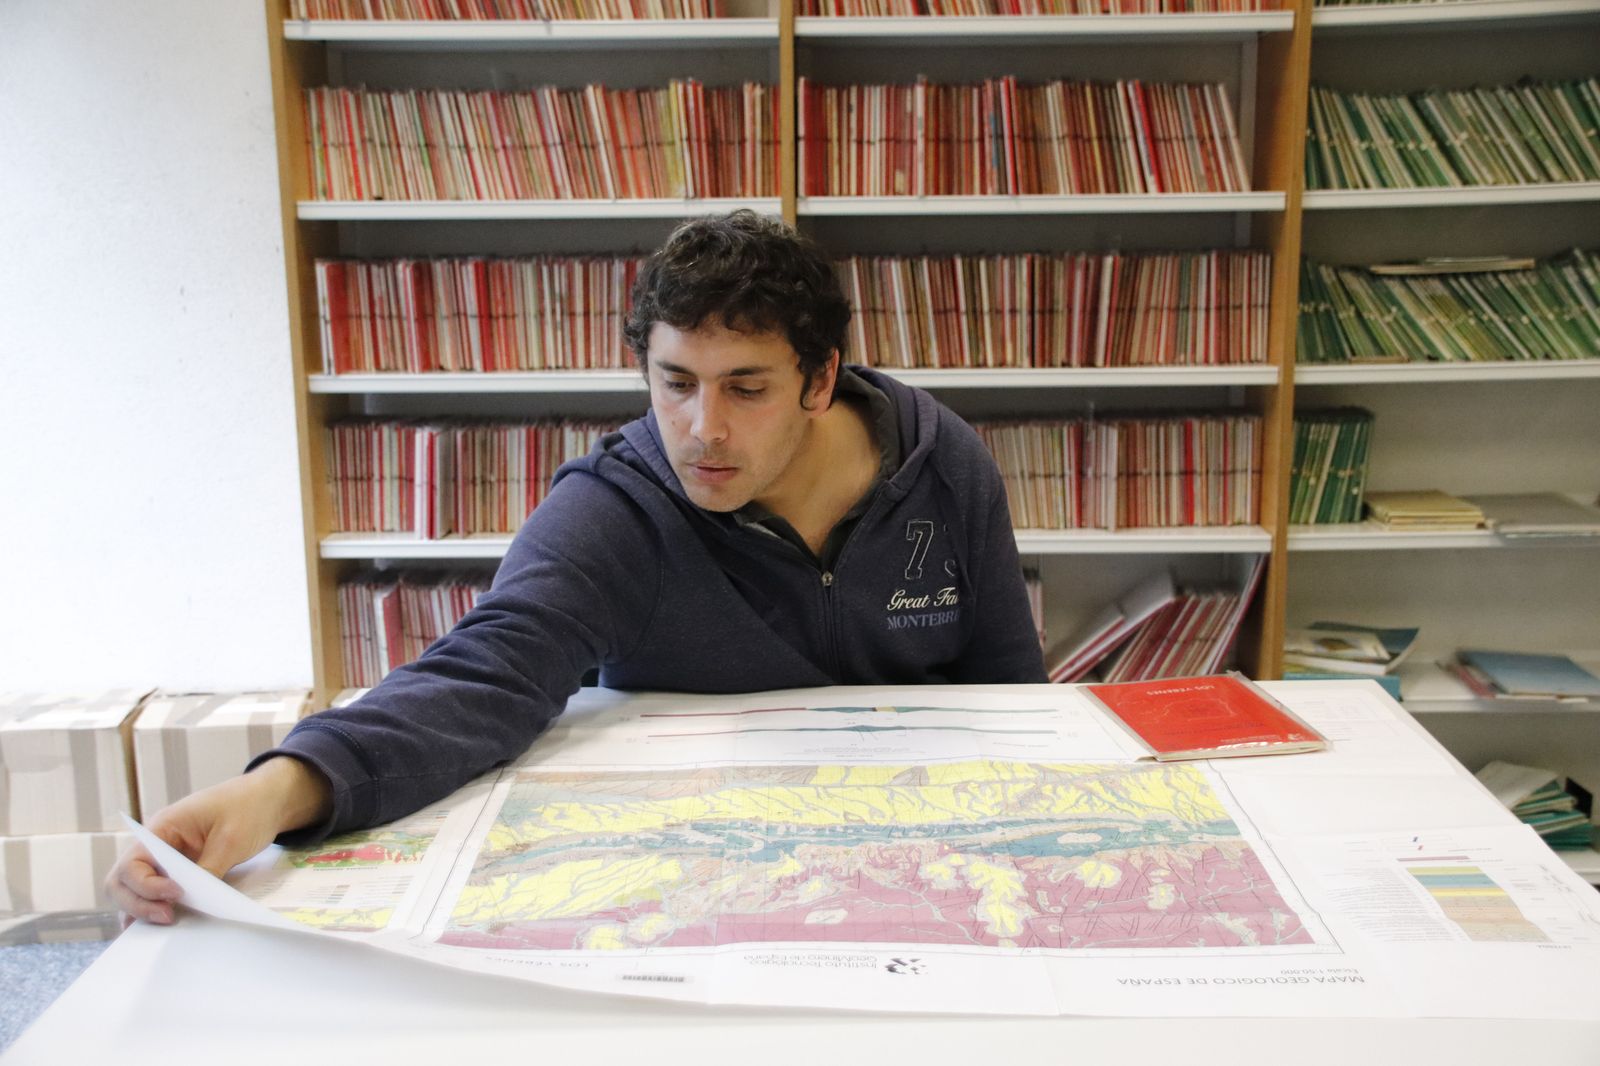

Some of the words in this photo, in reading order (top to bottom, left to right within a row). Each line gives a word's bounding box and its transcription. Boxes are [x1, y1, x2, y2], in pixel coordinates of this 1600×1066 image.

[887, 588, 931, 611] Great
[1115, 977, 1182, 987] ESPAÑA
[1186, 977, 1209, 986] DE
[1211, 976, 1311, 986] GEOLOGICO
[1312, 975, 1366, 984] MAPA
